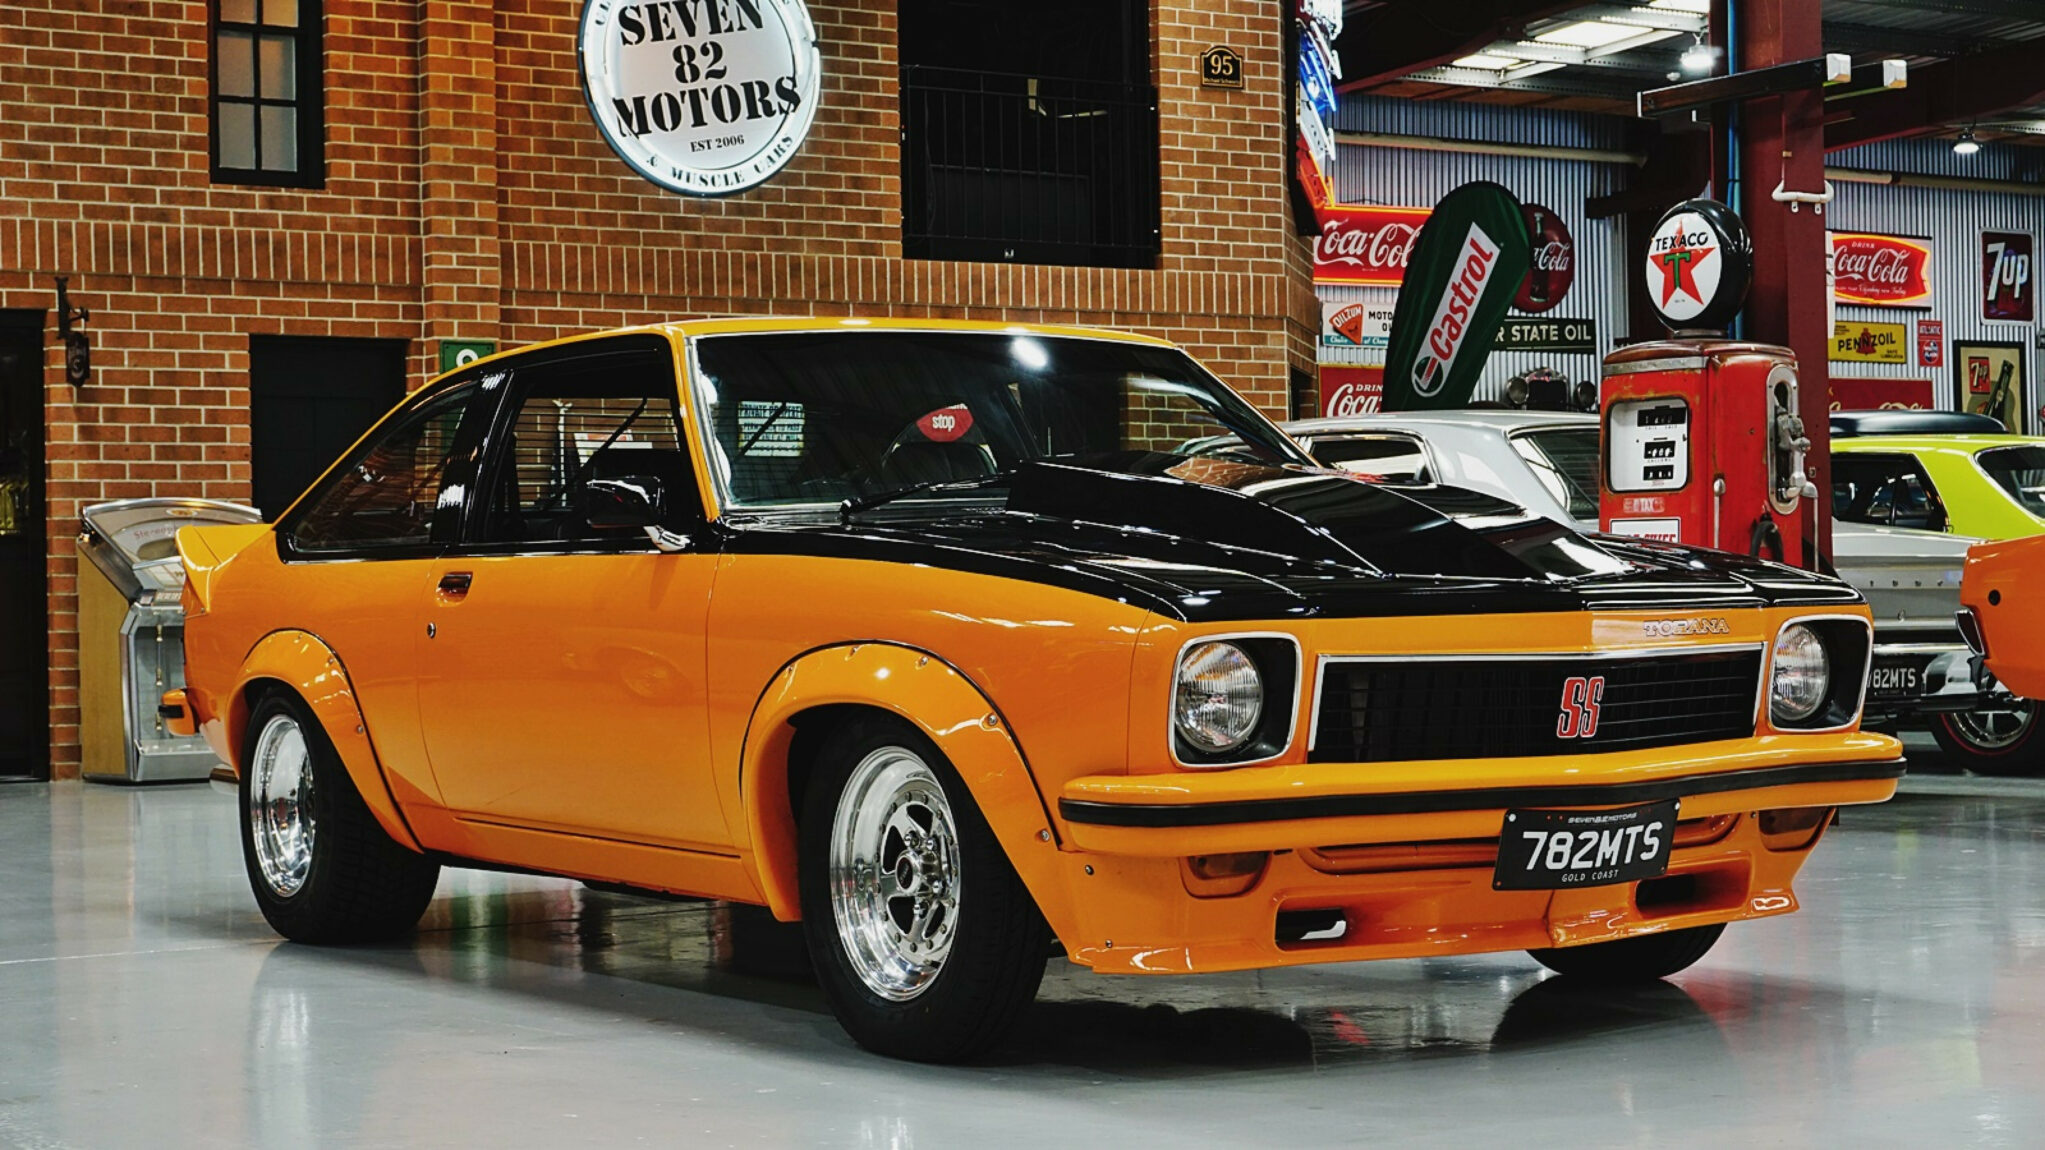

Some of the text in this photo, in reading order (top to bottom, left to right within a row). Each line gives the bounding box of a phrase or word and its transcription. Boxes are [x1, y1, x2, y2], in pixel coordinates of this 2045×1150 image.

[618, 0, 763, 46] SEVEN
[672, 41, 728, 84] 82
[1210, 54, 1233, 75] 95
[613, 76, 801, 139] MOTORS
[690, 134, 745, 152] EST 2006
[671, 166, 745, 188] MUSCLE
[753, 133, 793, 174] CARS
[1655, 232, 1708, 251] TEXACO
[1851, 241, 1875, 249] DRINK
[1430, 237, 1493, 361] Castrol
[1511, 325, 1559, 342] STATE
[1564, 324, 1592, 341] OIL
[1838, 332, 1896, 352] PENNZOIL
[1355, 384, 1383, 392] DRIN
[932, 414, 955, 432] stop
[1643, 618, 1730, 637] TORANA
[1556, 676, 1605, 738] SS
[1522, 821, 1664, 871] 782MTS
[1561, 869, 1620, 882] GOLD COAST
